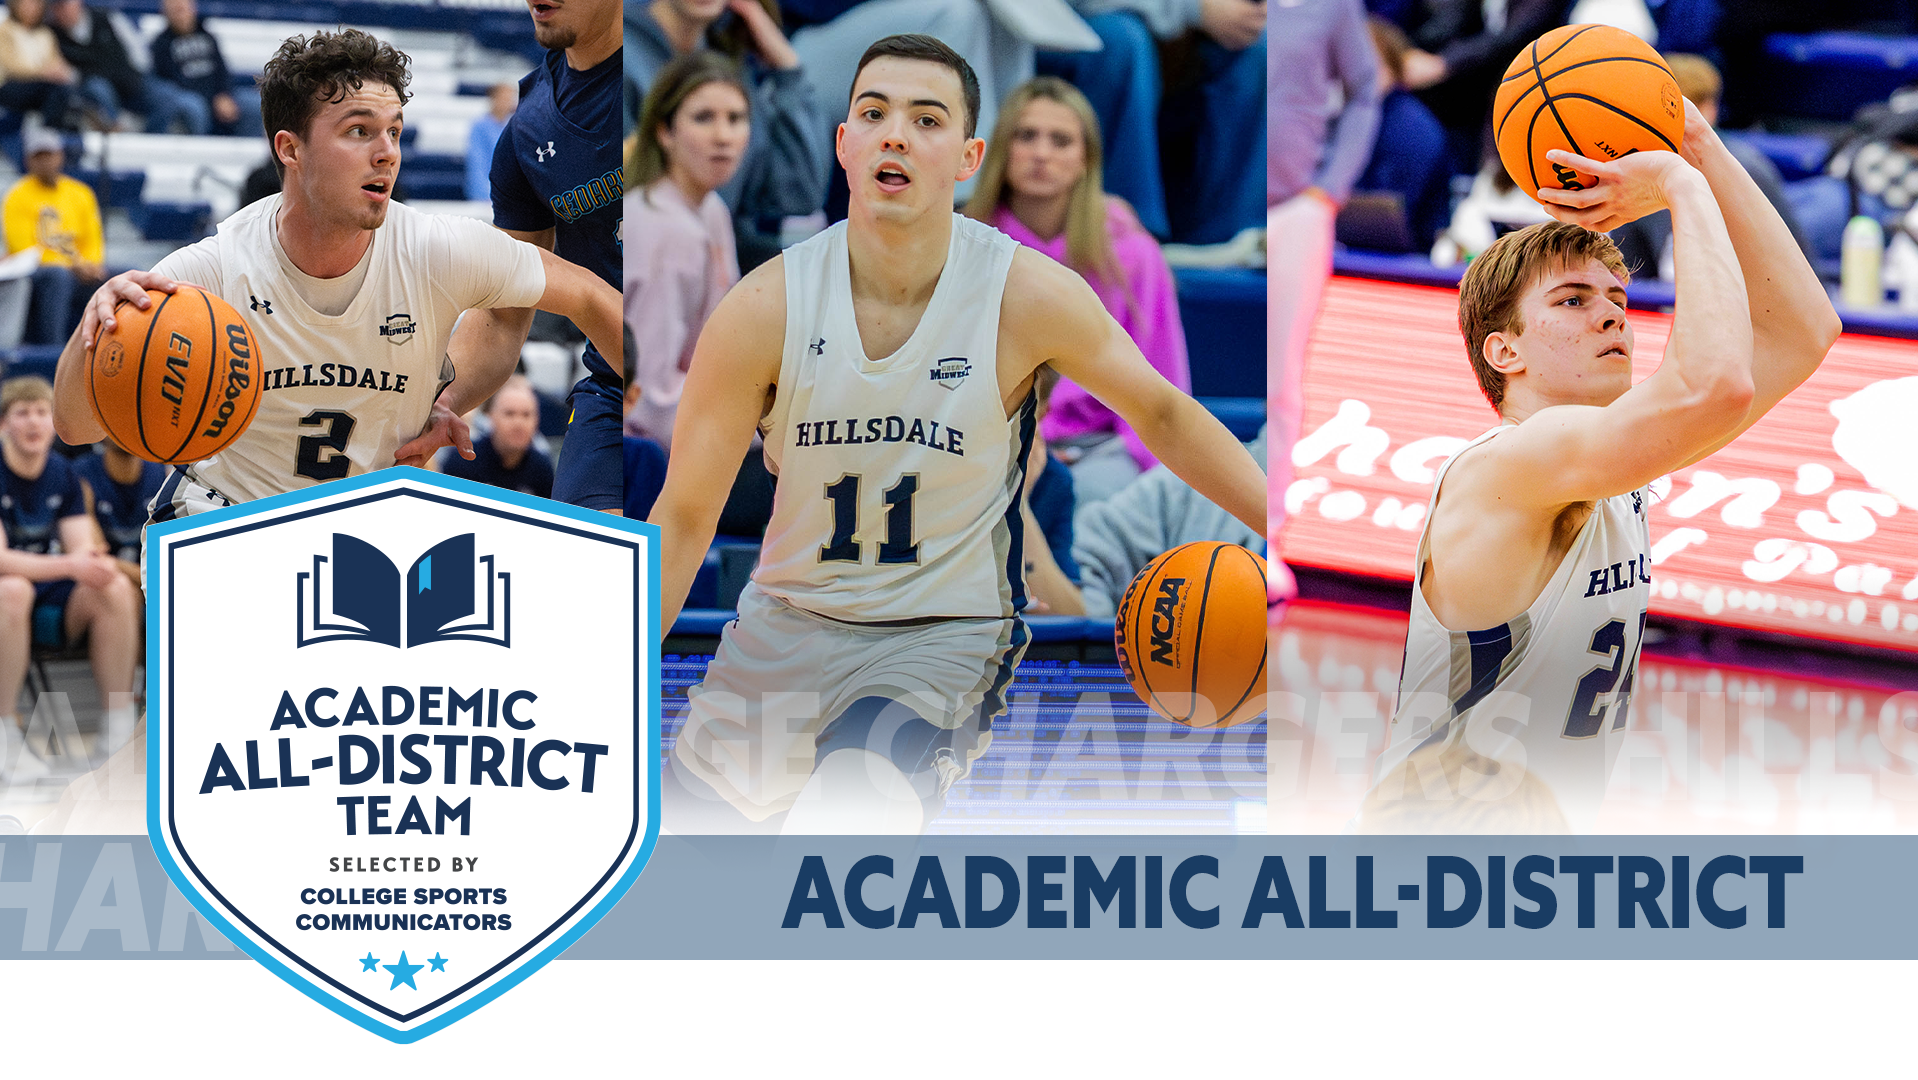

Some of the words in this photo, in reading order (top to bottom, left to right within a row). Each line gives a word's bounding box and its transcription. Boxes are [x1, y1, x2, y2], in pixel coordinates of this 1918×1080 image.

[1594, 140, 1618, 158] NXT
[202, 323, 250, 438] Wilson
[929, 365, 972, 380] MIDWEST
[170, 406, 181, 428] NXT
[293, 408, 357, 482] 2
[795, 415, 964, 456] HILLSDALE
[817, 472, 921, 566] 11
[1151, 577, 1186, 667] NCAA
